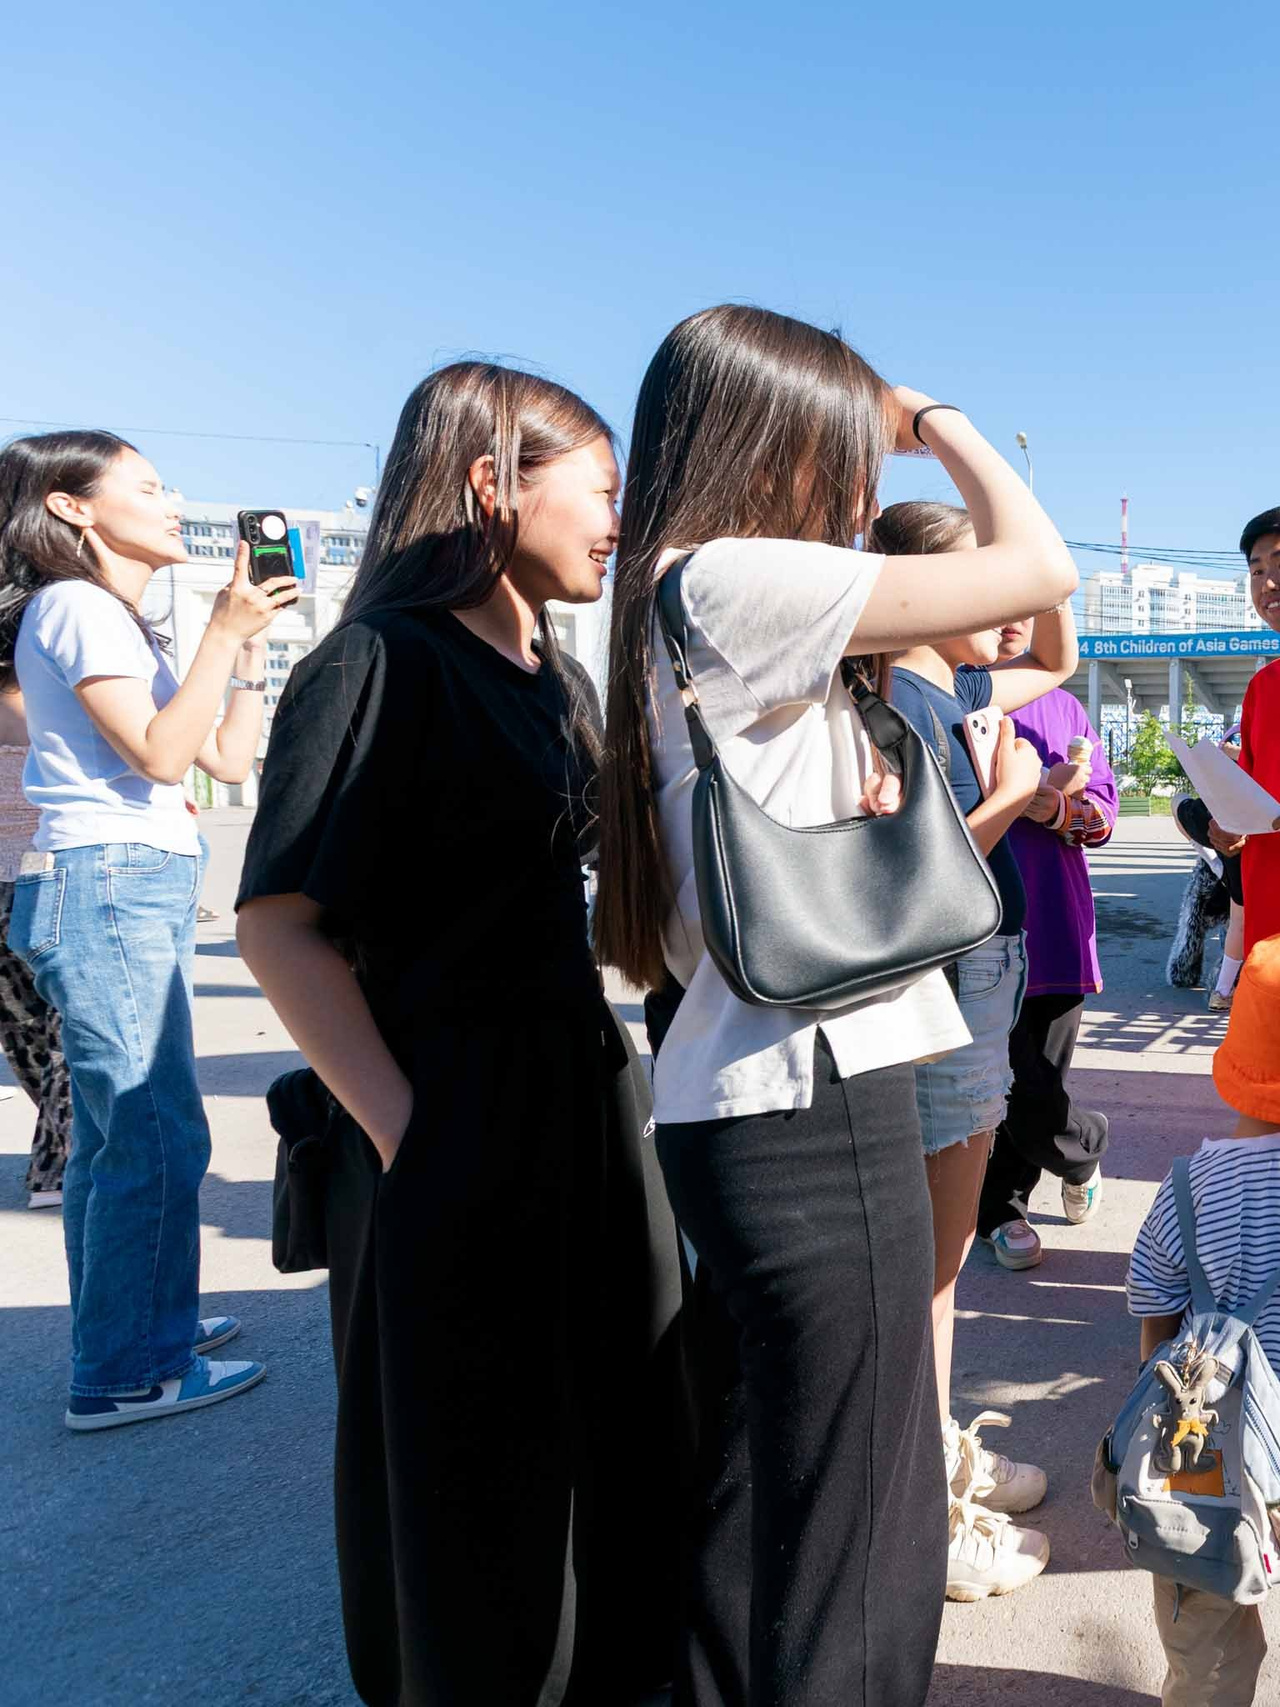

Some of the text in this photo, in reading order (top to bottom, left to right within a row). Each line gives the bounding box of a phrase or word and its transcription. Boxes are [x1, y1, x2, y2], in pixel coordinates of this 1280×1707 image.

[1094, 642, 1117, 654] 8th
[1120, 640, 1176, 655] Children
[1179, 639, 1193, 653] of
[1195, 638, 1226, 653] Asia
[1229, 637, 1280, 652] Games
